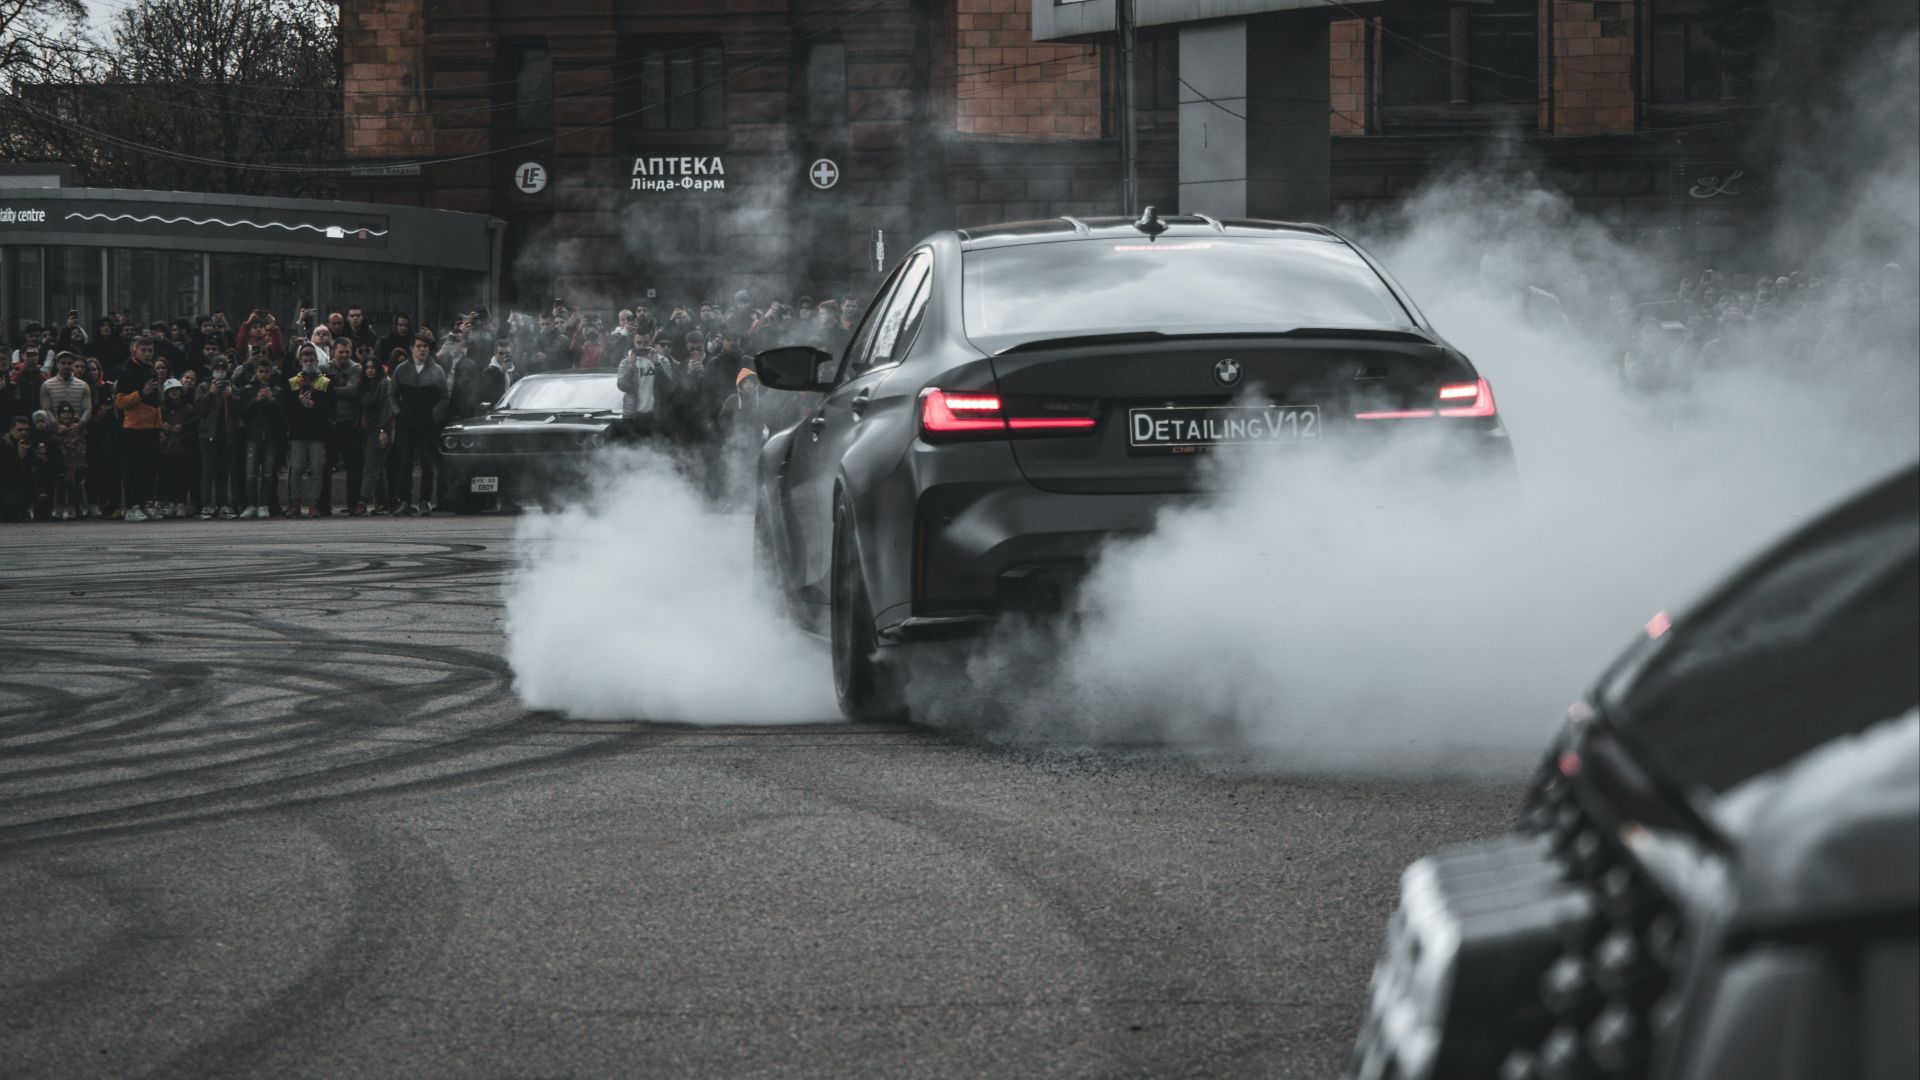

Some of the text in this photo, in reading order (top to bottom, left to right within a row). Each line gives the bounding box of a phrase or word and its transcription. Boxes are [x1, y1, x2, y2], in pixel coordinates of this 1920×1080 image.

[632, 157, 725, 176] АПТЕКА
[630, 176, 725, 192] Лінда-Фарм
[18, 208, 46, 222] centre
